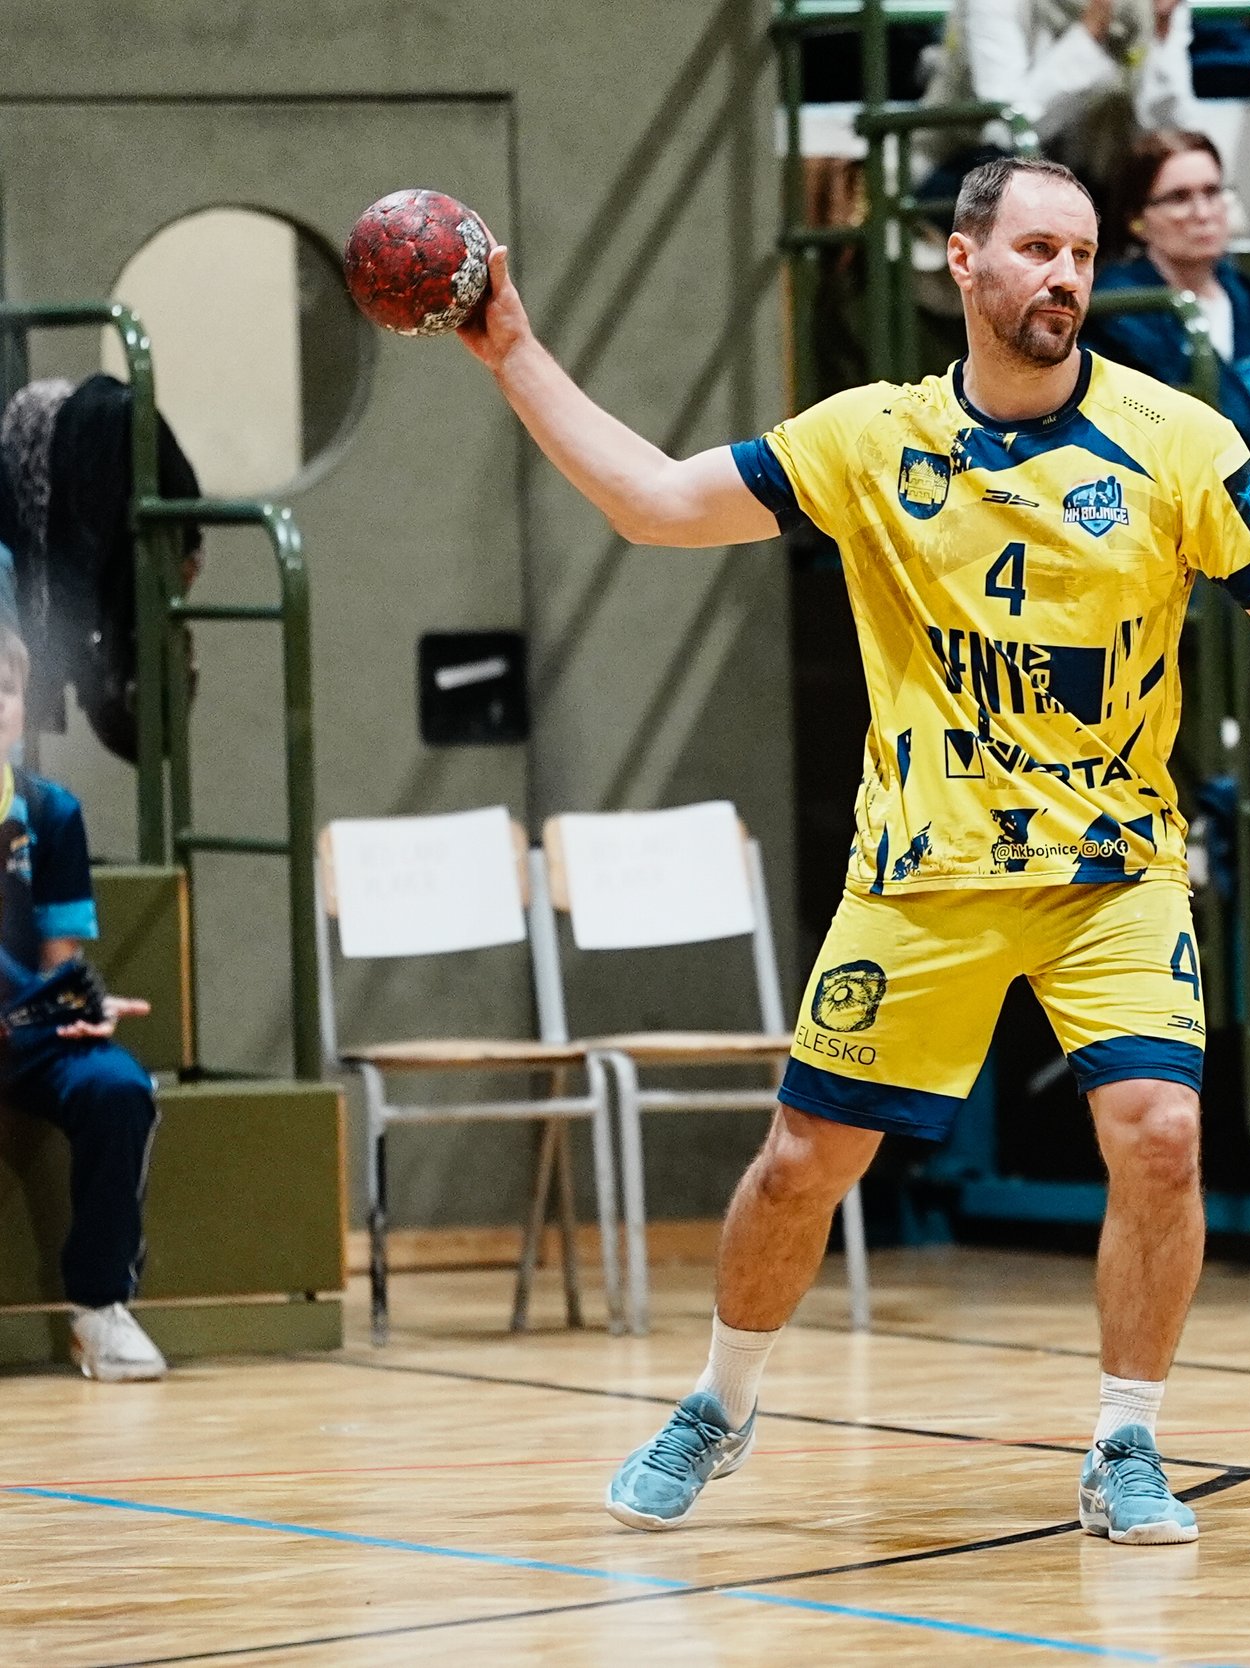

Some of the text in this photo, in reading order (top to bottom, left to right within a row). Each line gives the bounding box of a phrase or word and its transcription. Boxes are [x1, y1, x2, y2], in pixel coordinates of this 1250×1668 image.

[1064, 506, 1128, 526] HK BOJNICE
[985, 541, 1026, 616] 4
[996, 843, 1078, 860] @hkbojnice
[1169, 931, 1201, 1002] 4
[795, 1025, 876, 1066] ELESKO
